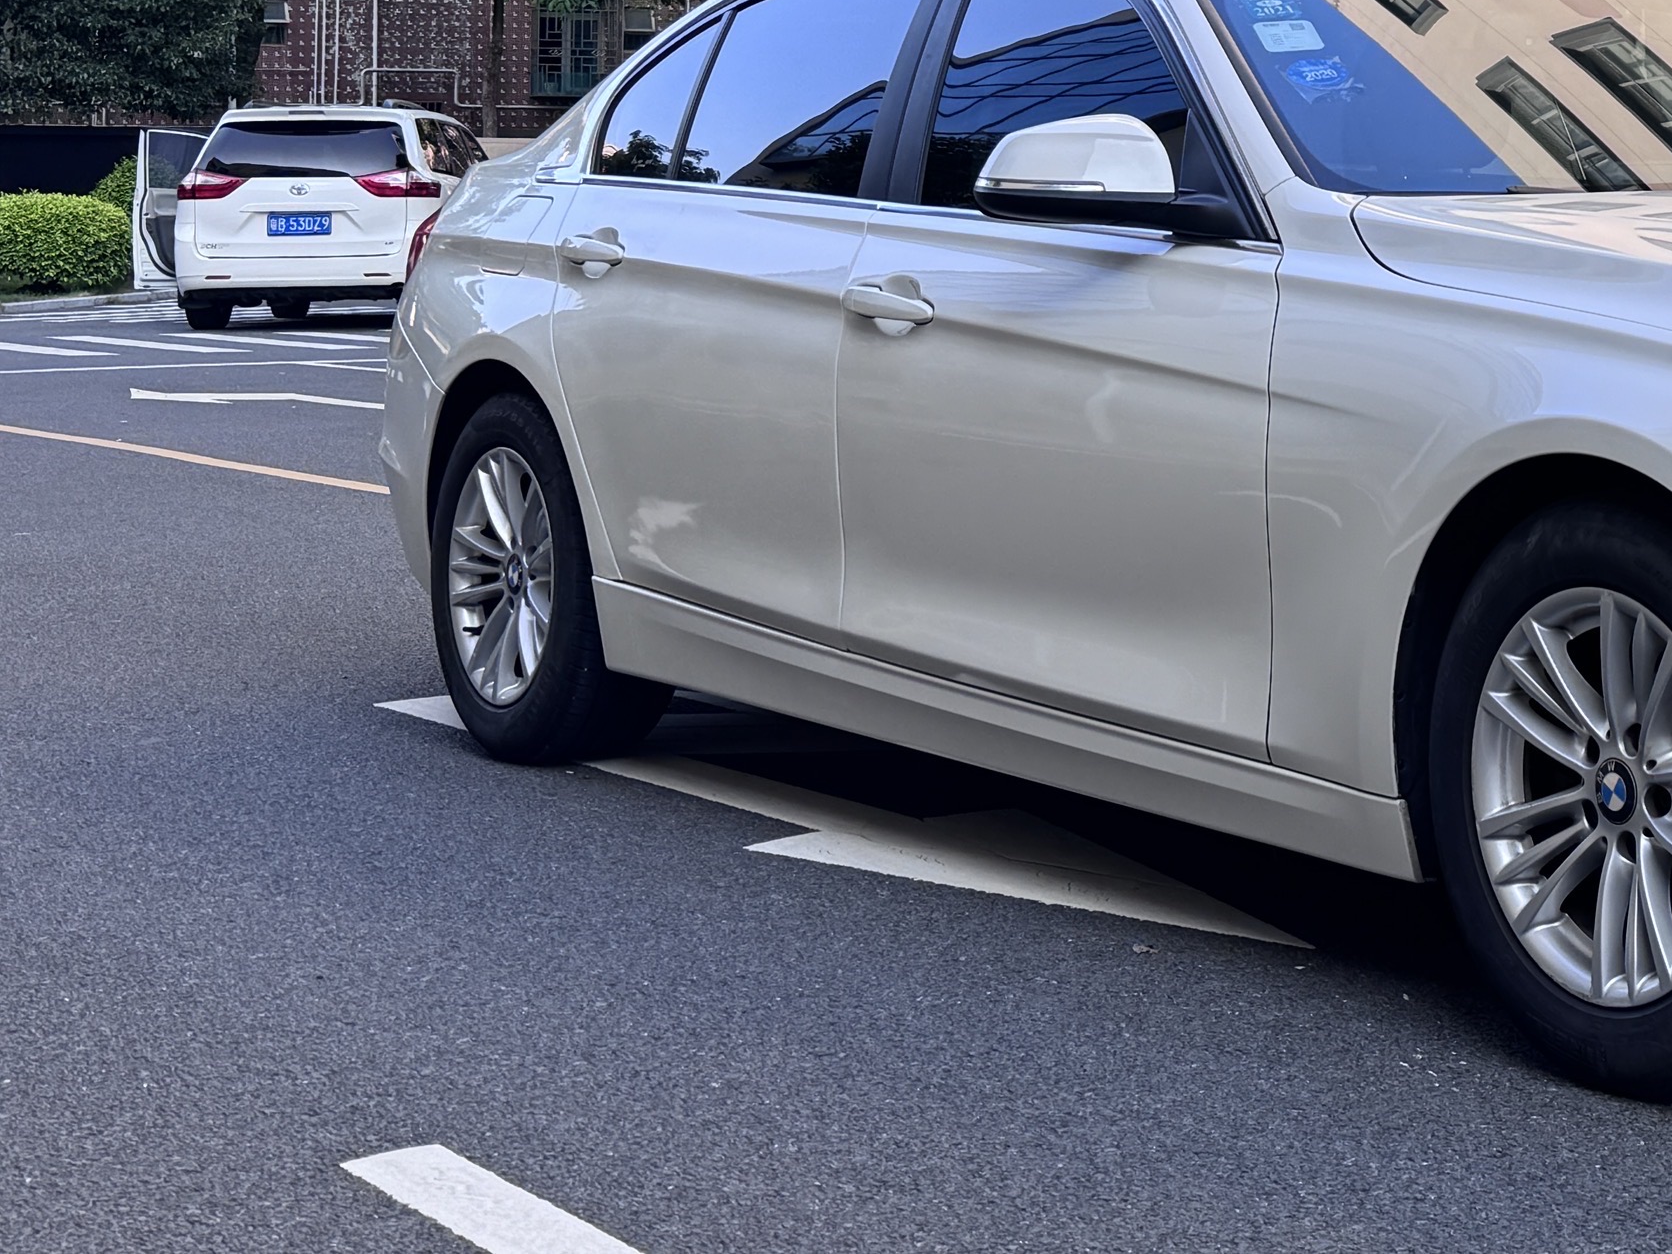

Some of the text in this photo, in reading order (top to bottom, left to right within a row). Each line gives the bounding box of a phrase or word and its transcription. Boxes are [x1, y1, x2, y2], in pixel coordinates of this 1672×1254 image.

[1253, 5, 1294, 17] 2021
[1302, 69, 1338, 82] 2020
[1596, 760, 1616, 804] BMW
